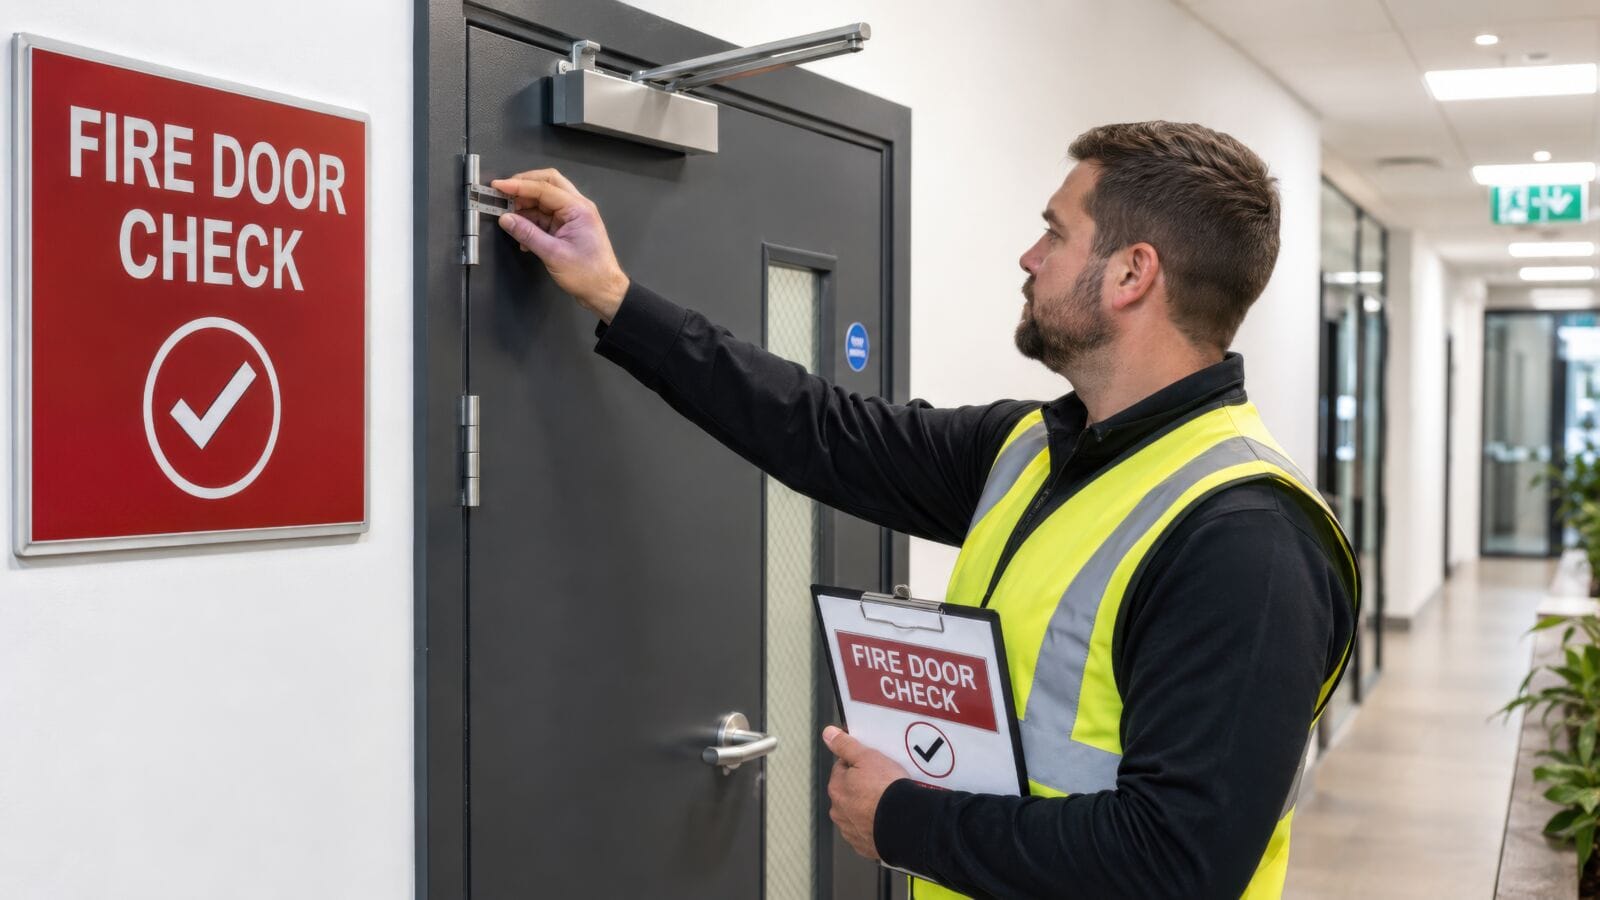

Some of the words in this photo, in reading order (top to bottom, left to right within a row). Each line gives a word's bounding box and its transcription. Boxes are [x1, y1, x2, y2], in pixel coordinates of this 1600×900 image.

[69, 104, 194, 194] FIRE
[213, 132, 347, 216] DOOR
[119, 208, 305, 291] CHECK
[851, 643, 904, 675] FIRE
[907, 653, 977, 690] DOOR
[880, 675, 960, 714] CHECK
